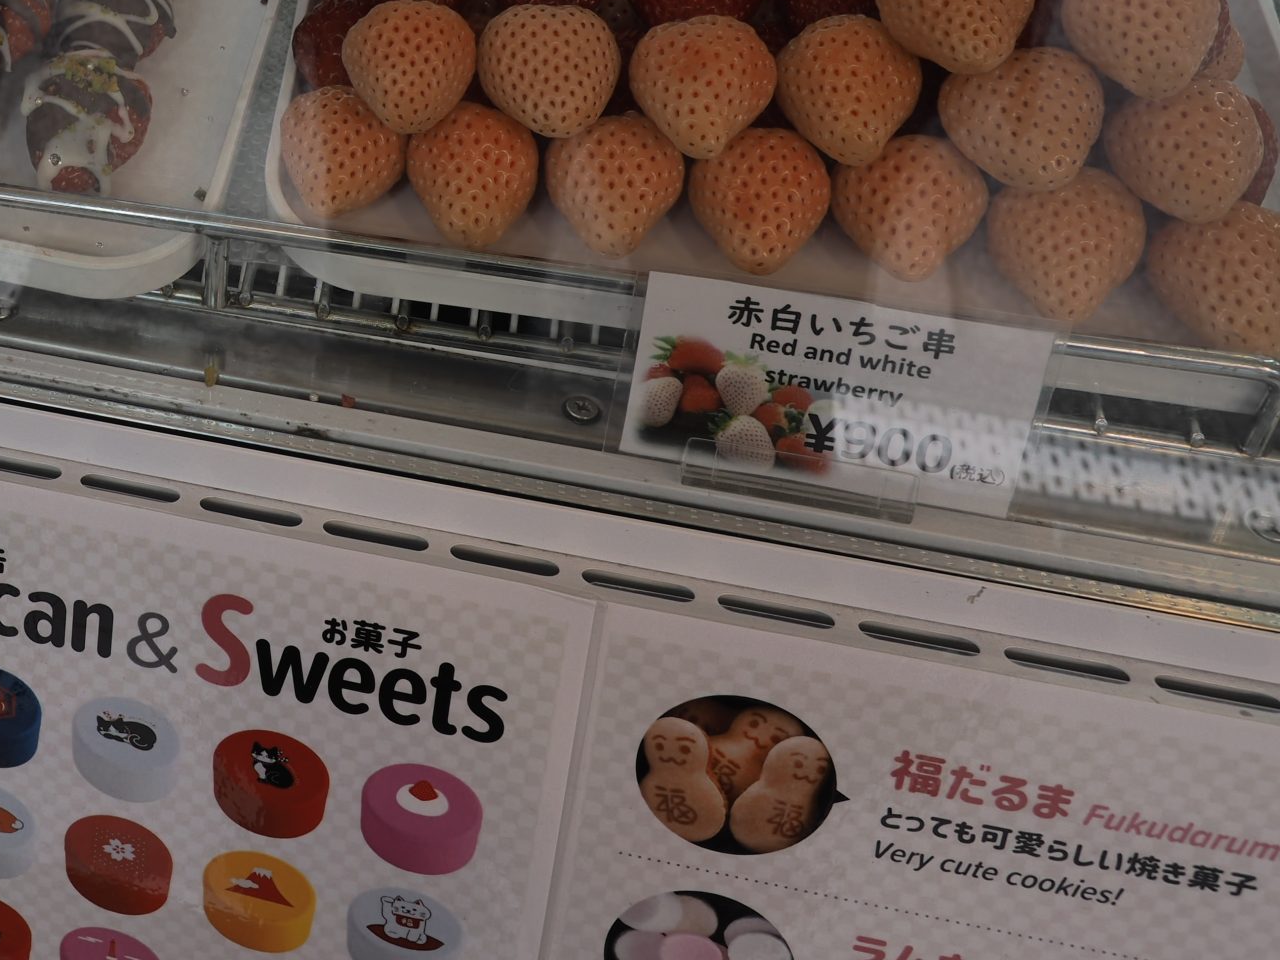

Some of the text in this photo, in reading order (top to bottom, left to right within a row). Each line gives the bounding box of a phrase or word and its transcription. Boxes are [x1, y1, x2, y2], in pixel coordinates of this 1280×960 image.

[727, 296, 957, 360] 赤白いちご串
[749, 332, 932, 380] Red and white
[764, 367, 904, 408] strawberry
[126, 611, 179, 675] &
[194, 593, 509, 744] Sweets
[321, 617, 423, 658] お菓子
[890, 749, 1075, 819] 福だるま
[874, 839, 1124, 906] Very cute cookies!
[880, 807, 1258, 897] とっても可愛らしい焼き菓子
